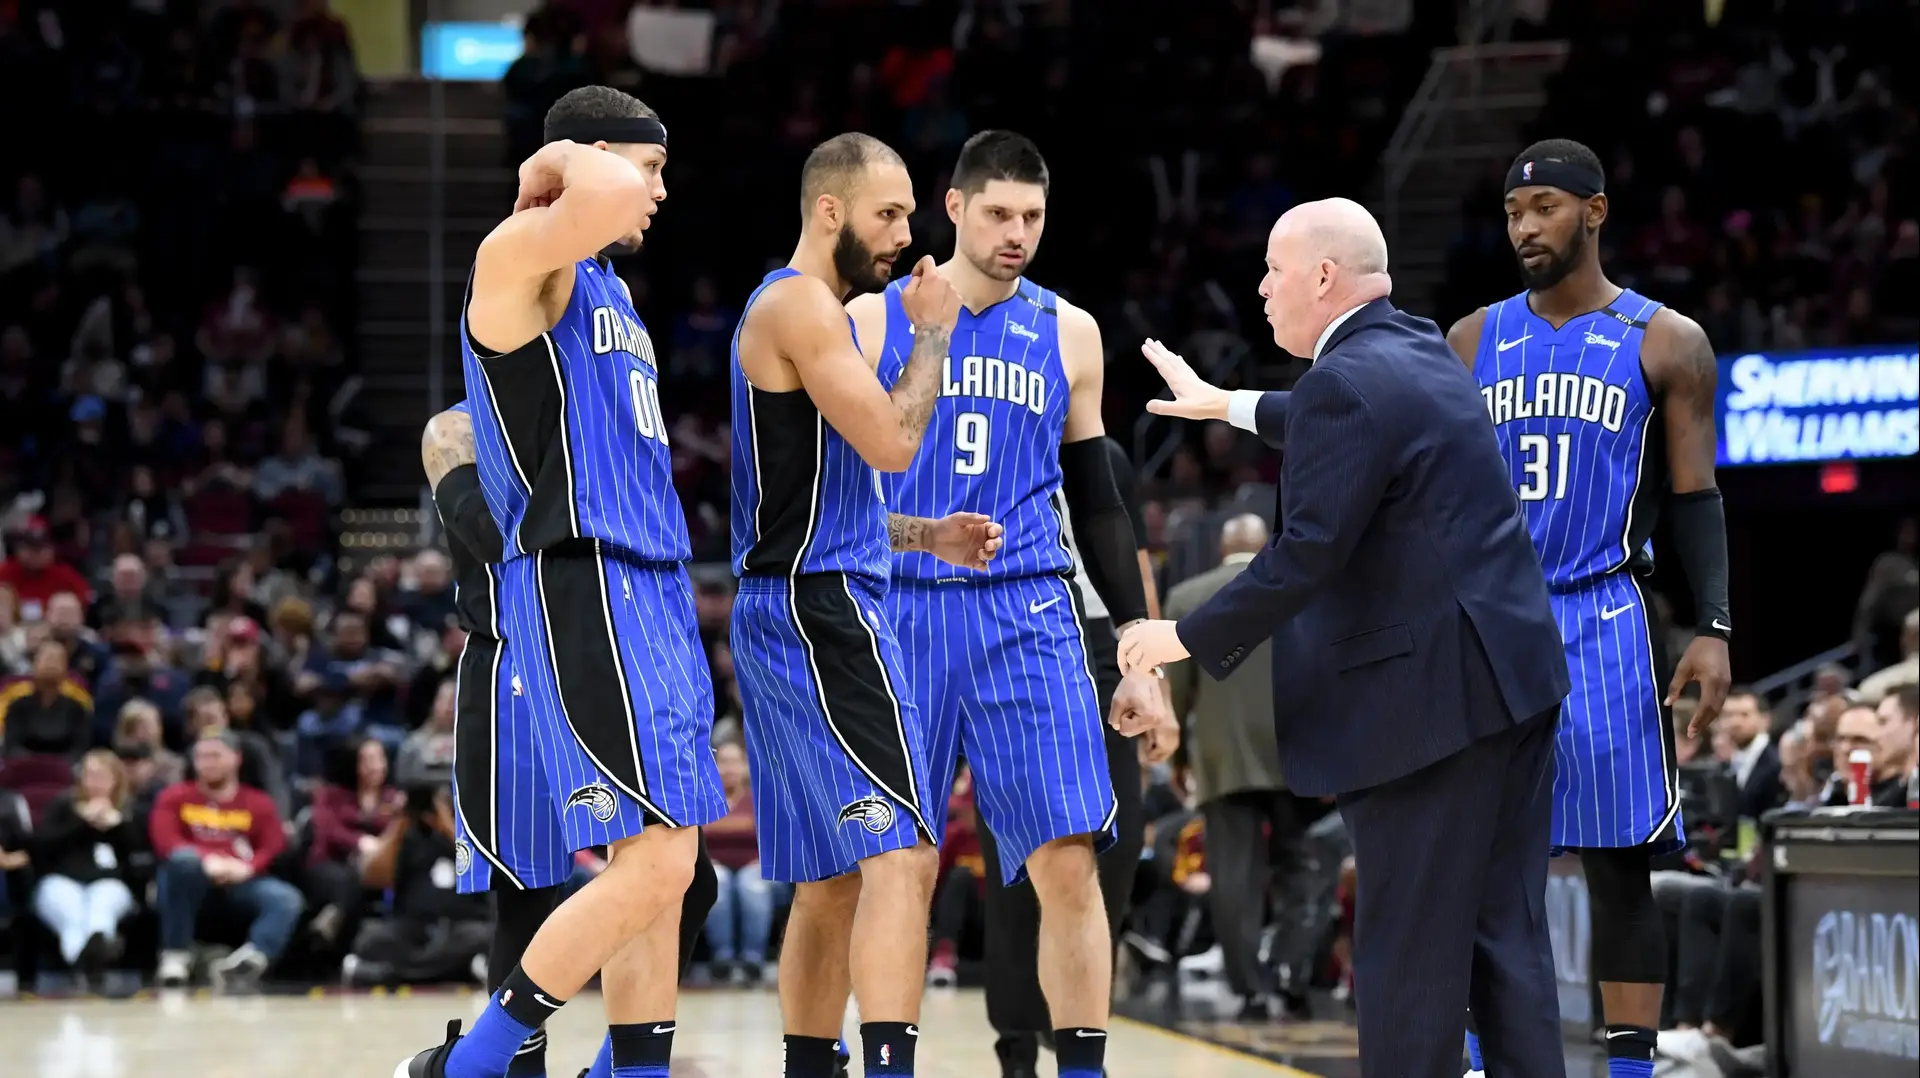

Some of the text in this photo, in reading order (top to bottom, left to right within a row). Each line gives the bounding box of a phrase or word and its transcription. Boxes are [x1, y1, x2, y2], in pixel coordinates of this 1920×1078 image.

[592, 304, 659, 375] ORLAND
[1006, 319, 1040, 343] Disney
[1583, 331, 1621, 352] Disney
[1614, 312, 1635, 326] RDV
[629, 367, 670, 448] 00
[898, 355, 1047, 416] LANDO
[1480, 371, 1628, 434] ORLANDO
[954, 411, 989, 477] 9
[1518, 432, 1572, 502] 31
